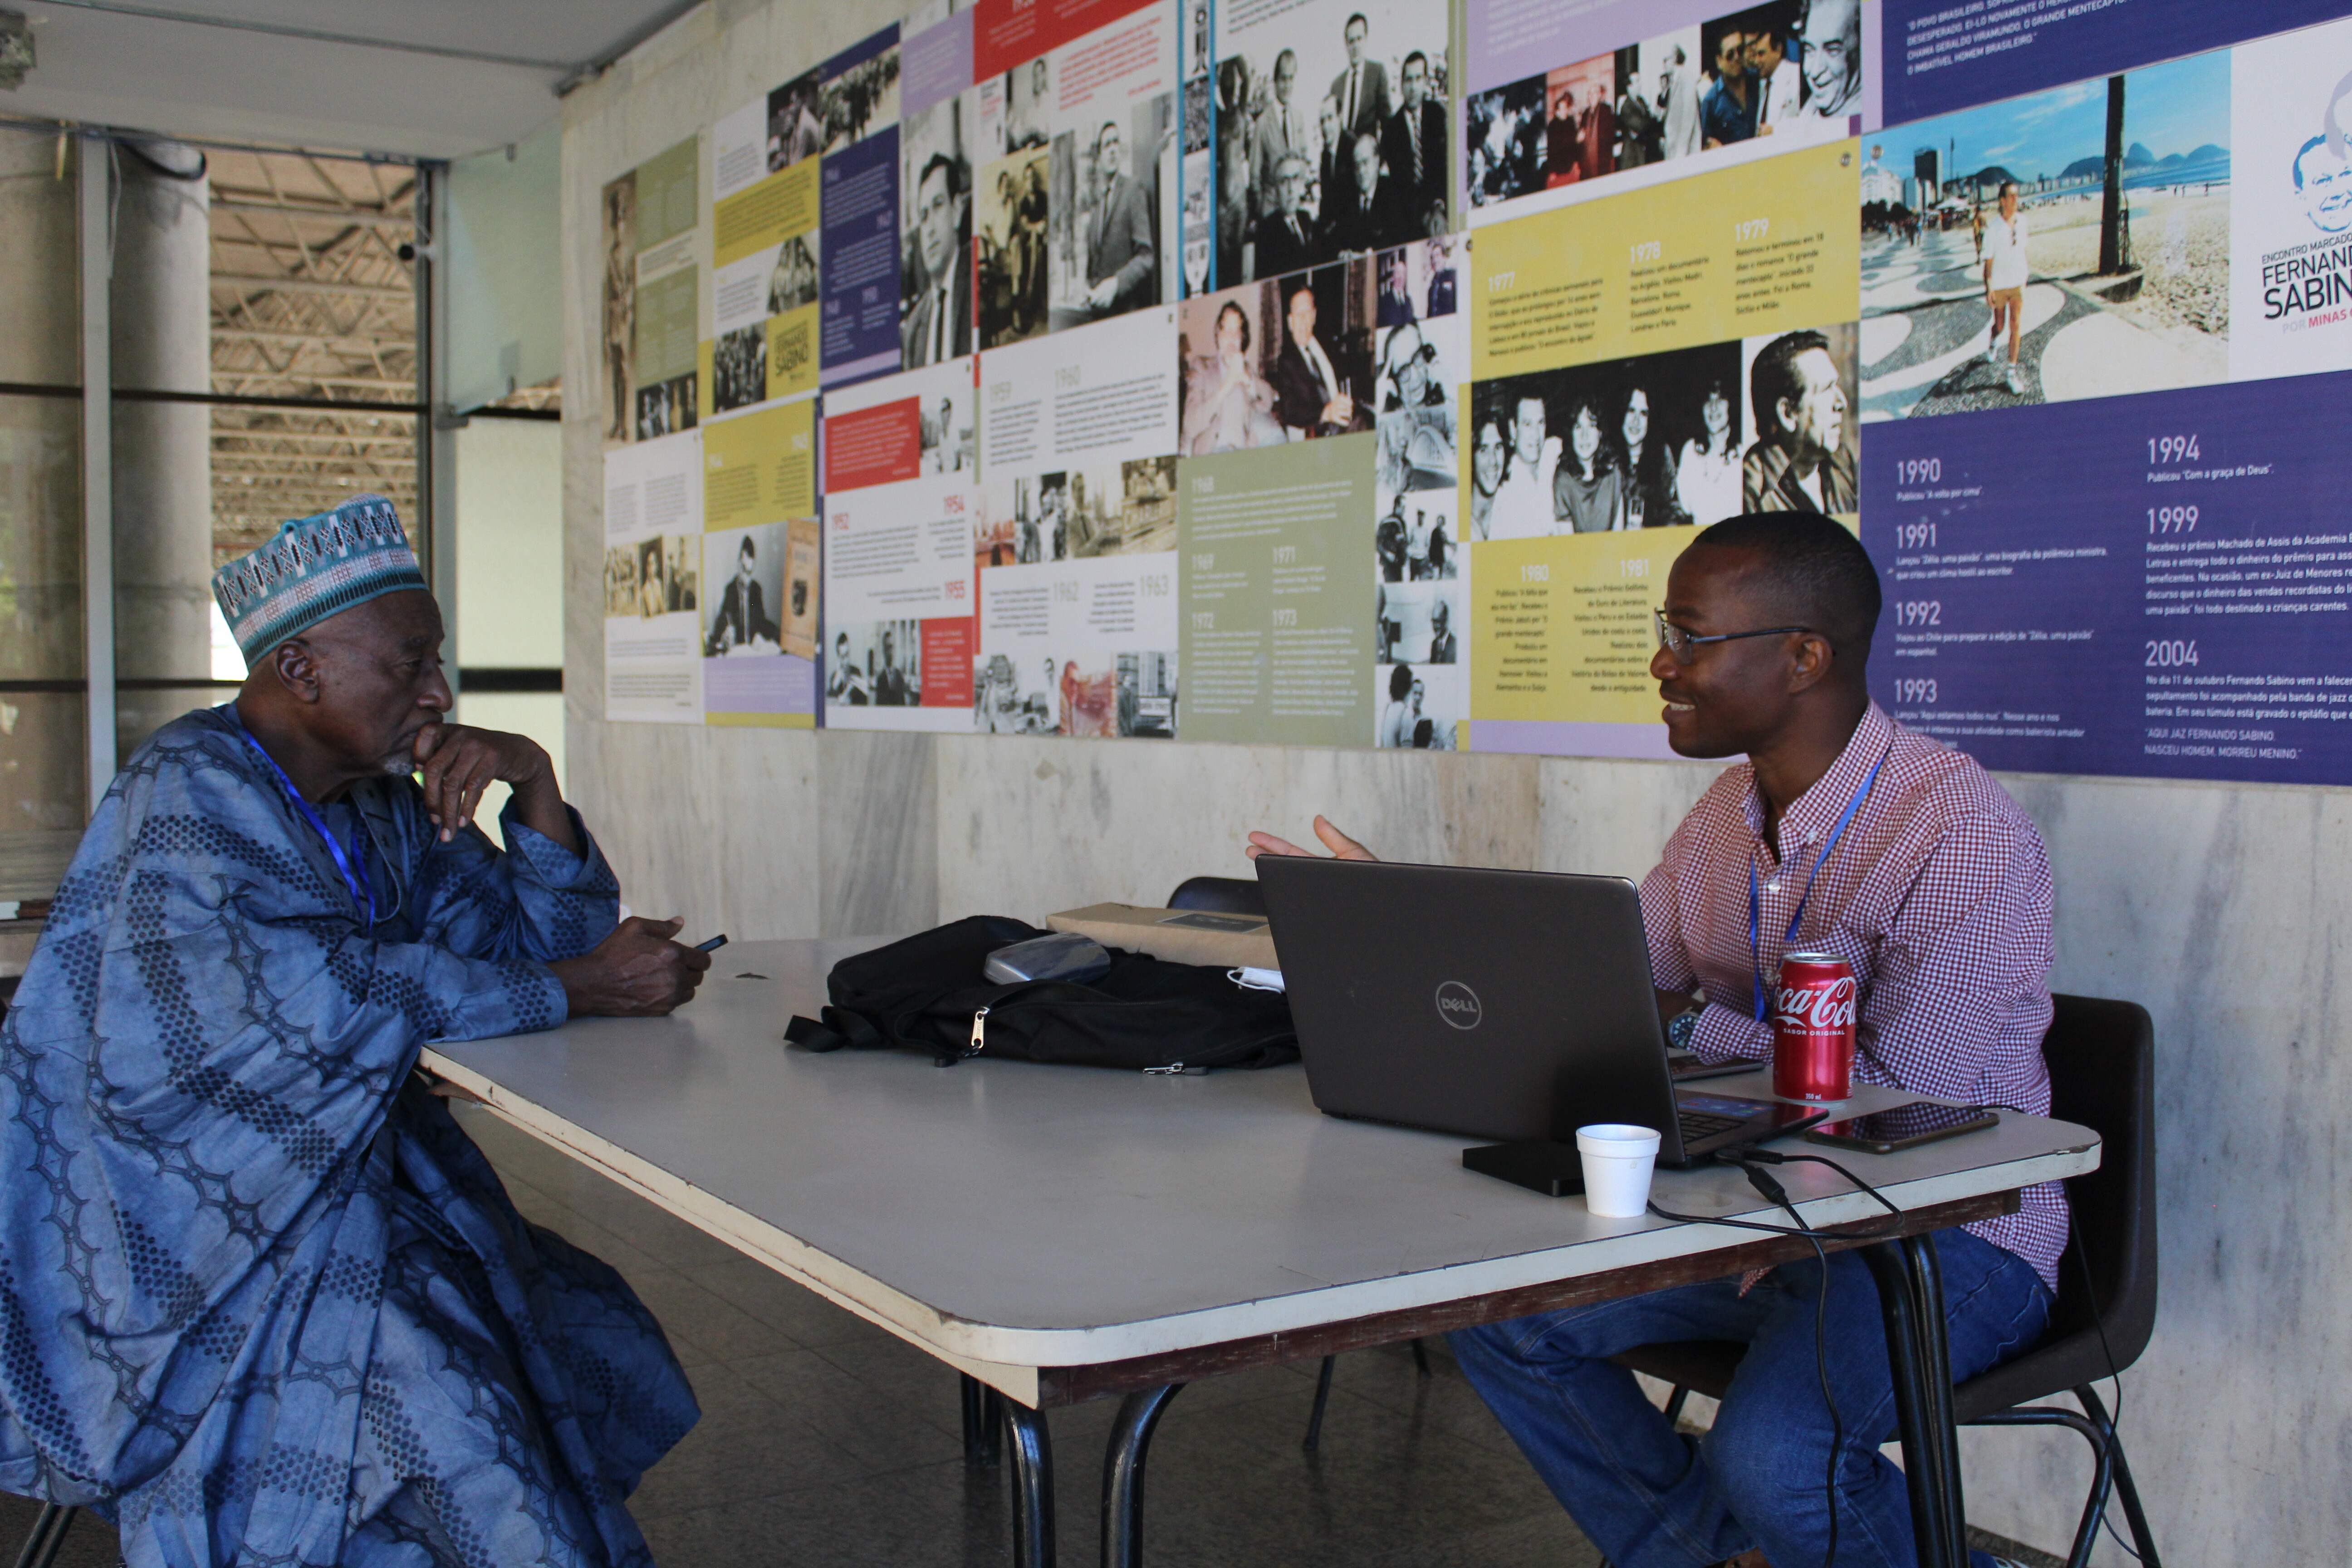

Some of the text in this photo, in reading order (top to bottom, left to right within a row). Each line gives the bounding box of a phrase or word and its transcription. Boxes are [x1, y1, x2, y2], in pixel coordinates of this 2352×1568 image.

[1988, 1, 2037, 24] NOVAMENTE
[1907, 45, 1935, 61] CHAMA
[1935, 34, 1972, 53] GERALDO
[2024, 18, 2030, 29] O
[2031, 8, 2067, 27] GRANDE
[1907, 64, 1914, 76] O
[1954, 46, 1984, 63] HOMEM
[1735, 217, 1769, 242] 1979
[1630, 240, 1661, 264] 1978
[2262, 233, 2352, 265] ENCONTRO MARCADO
[1488, 271, 1516, 293] 1977
[2283, 309, 2347, 333] POR MINAS
[2148, 434, 2200, 465] 1994
[1897, 458, 1940, 486] 1990
[2147, 470, 2180, 483] Publicou
[2182, 469, 2203, 480] "Com
[2211, 470, 2234, 480] graça
[2235, 466, 2246, 477] de
[2147, 505, 2198, 535] 1999
[1896, 523, 1936, 550] 1991
[2146, 541, 2180, 552] Recebeu
[2187, 539, 2216, 552] prêmio
[2217, 538, 2254, 549] Machado
[2255, 537, 2266, 547] de
[2267, 536, 2290, 546] Assis
[2292, 535, 2303, 545] da
[2304, 533, 2347, 544] Academia
[1273, 546, 1296, 564] 1971
[2146, 558, 2171, 568] Letras
[2179, 557, 2209, 568] entrega
[2210, 556, 2228, 565] todo
[2236, 555, 2270, 564] dinheiro
[2271, 554, 2283, 564] do
[2283, 554, 2314, 565] prêmio
[2316, 554, 2336, 564] para
[1521, 564, 1549, 582] 1980
[1620, 559, 1649, 578] 1981
[2198, 573, 2210, 582] Na
[2260, 570, 2292, 580] ex-Juiz
[2293, 569, 2304, 579] de
[2306, 568, 2343, 578] Menores
[2146, 590, 2179, 599] discurso
[2180, 592, 2195, 600] que
[2203, 588, 2236, 598] dinheiro
[2237, 588, 2253, 597] das
[2254, 587, 2283, 596] vendas
[2285, 585, 2332, 595] recordistas
[2334, 585, 2346, 594] do
[1273, 609, 1297, 626] 1973
[1896, 602, 1940, 627] 1992
[2194, 605, 2205, 614] foi
[2205, 605, 2223, 614] todo
[2225, 604, 2264, 613] destinado
[2272, 603, 2308, 614] crianças
[2145, 641, 2199, 667] 2004
[1895, 680, 1937, 704] 1993
[2146, 676, 2157, 685] No
[2158, 676, 2171, 685] dia
[2172, 676, 2180, 685] 11
[2183, 676, 2193, 685] de
[2194, 676, 2225, 685] outubro
[2226, 676, 2265, 685] Fernando
[2266, 676, 2295, 686] Sabino
[2146, 692, 2347, 704] sepultamento foi acompanhado pela banda de jazz
[2176, 708, 2189, 717] Em
[2206, 708, 2235, 717] túmulo
[2236, 709, 2254, 718] está
[2255, 709, 2289, 720] gravado
[2297, 710, 2329, 720] epitáfio
[2330, 712, 2347, 721] que
[2144, 745, 2180, 755] NASCEU
[2218, 747, 2257, 758] MORREU
[1441, 998, 1477, 1012] DELL
[1774, 975, 1856, 1028] oca-Col
